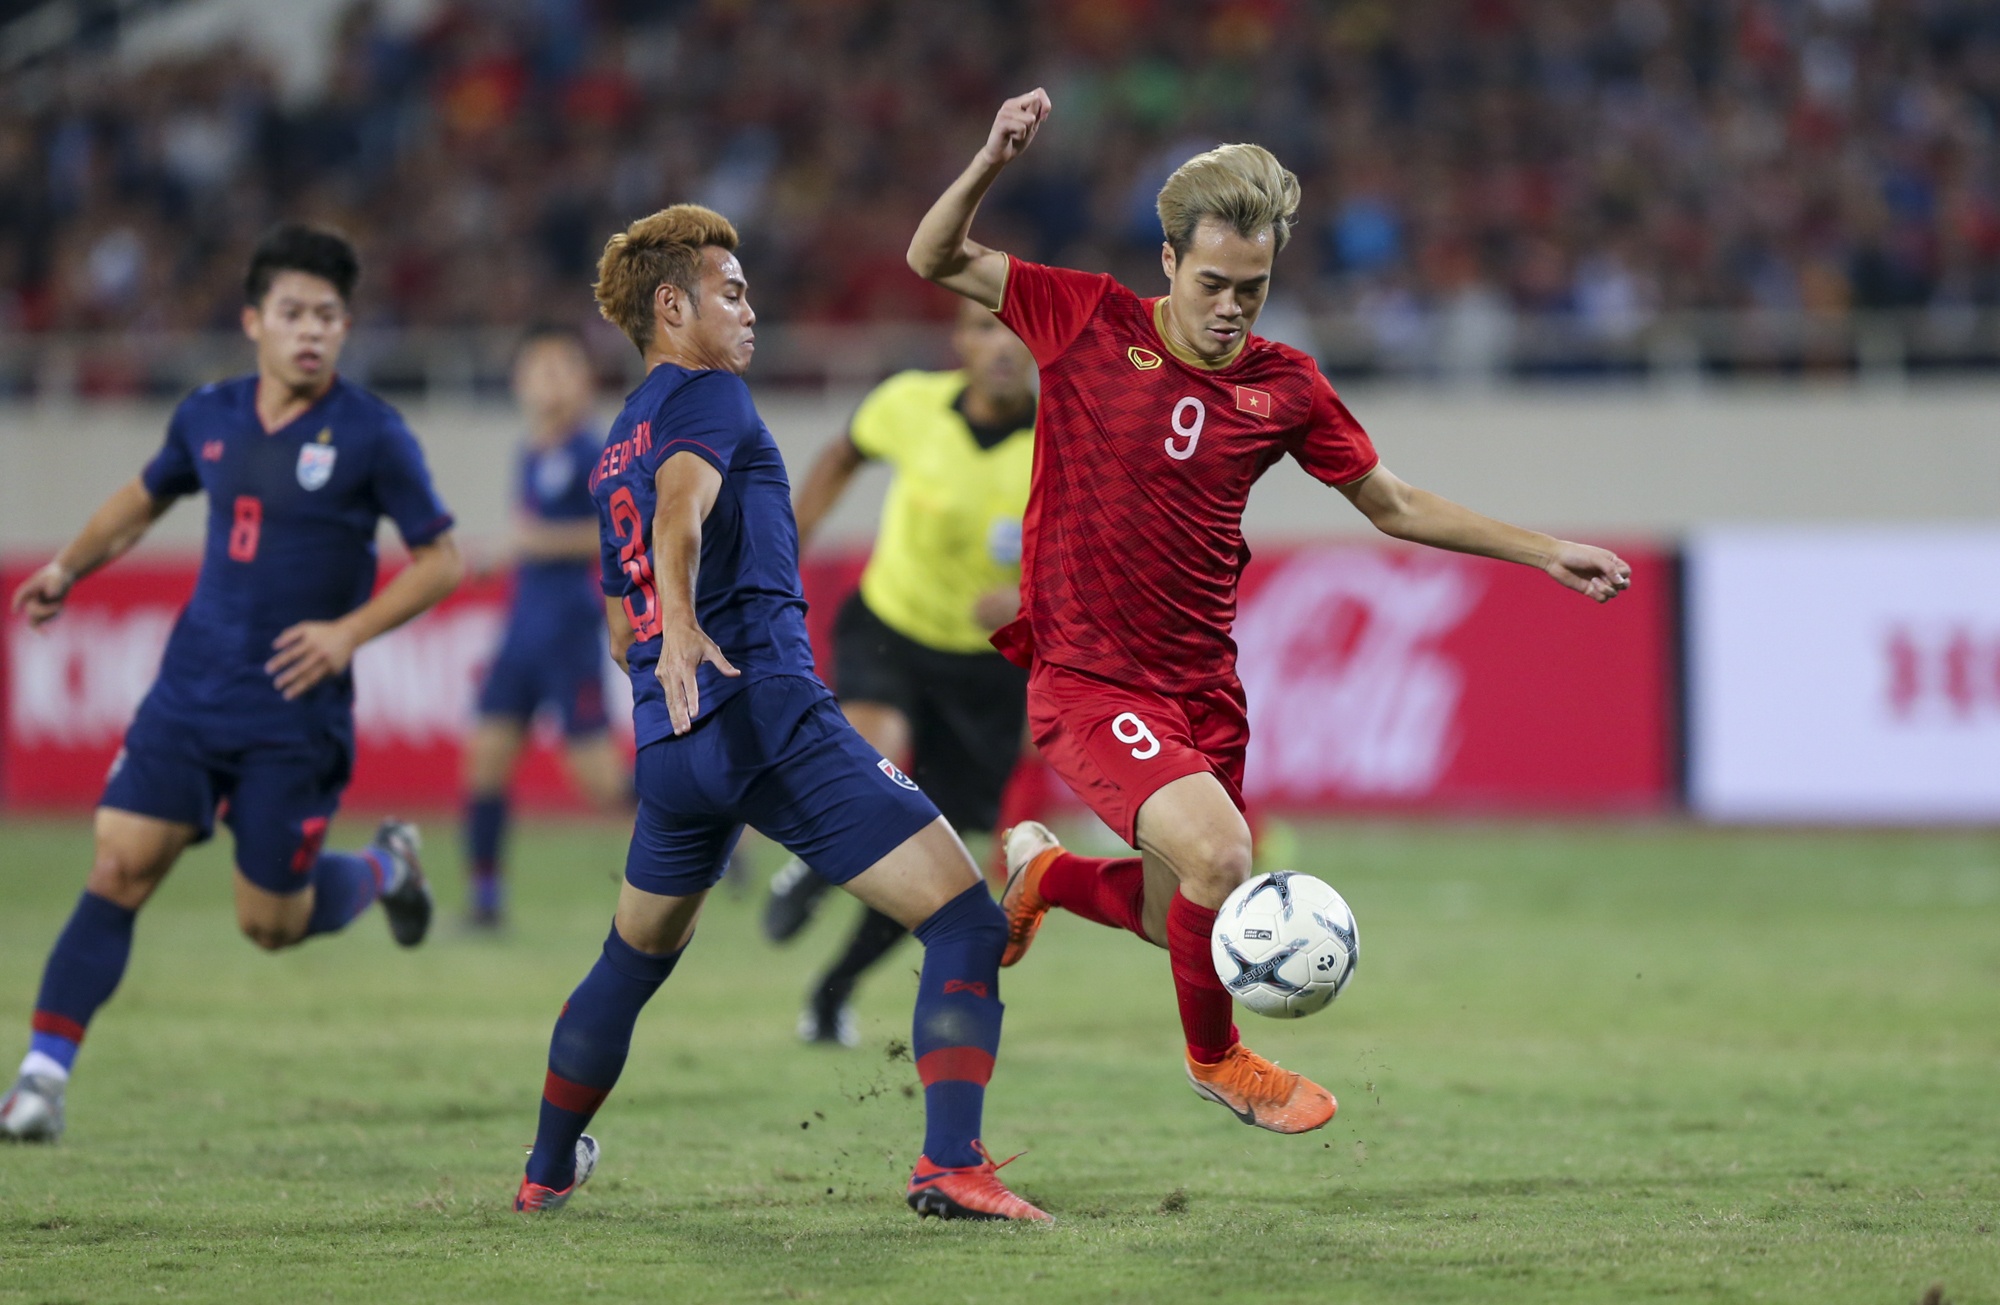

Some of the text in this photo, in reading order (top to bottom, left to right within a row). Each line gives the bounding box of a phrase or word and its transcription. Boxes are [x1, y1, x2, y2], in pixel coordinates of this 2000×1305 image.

[1164, 396, 1206, 461] 9
[228, 494, 263, 563] 8
[609, 486, 663, 642] 3
[1111, 712, 1161, 760] 9
